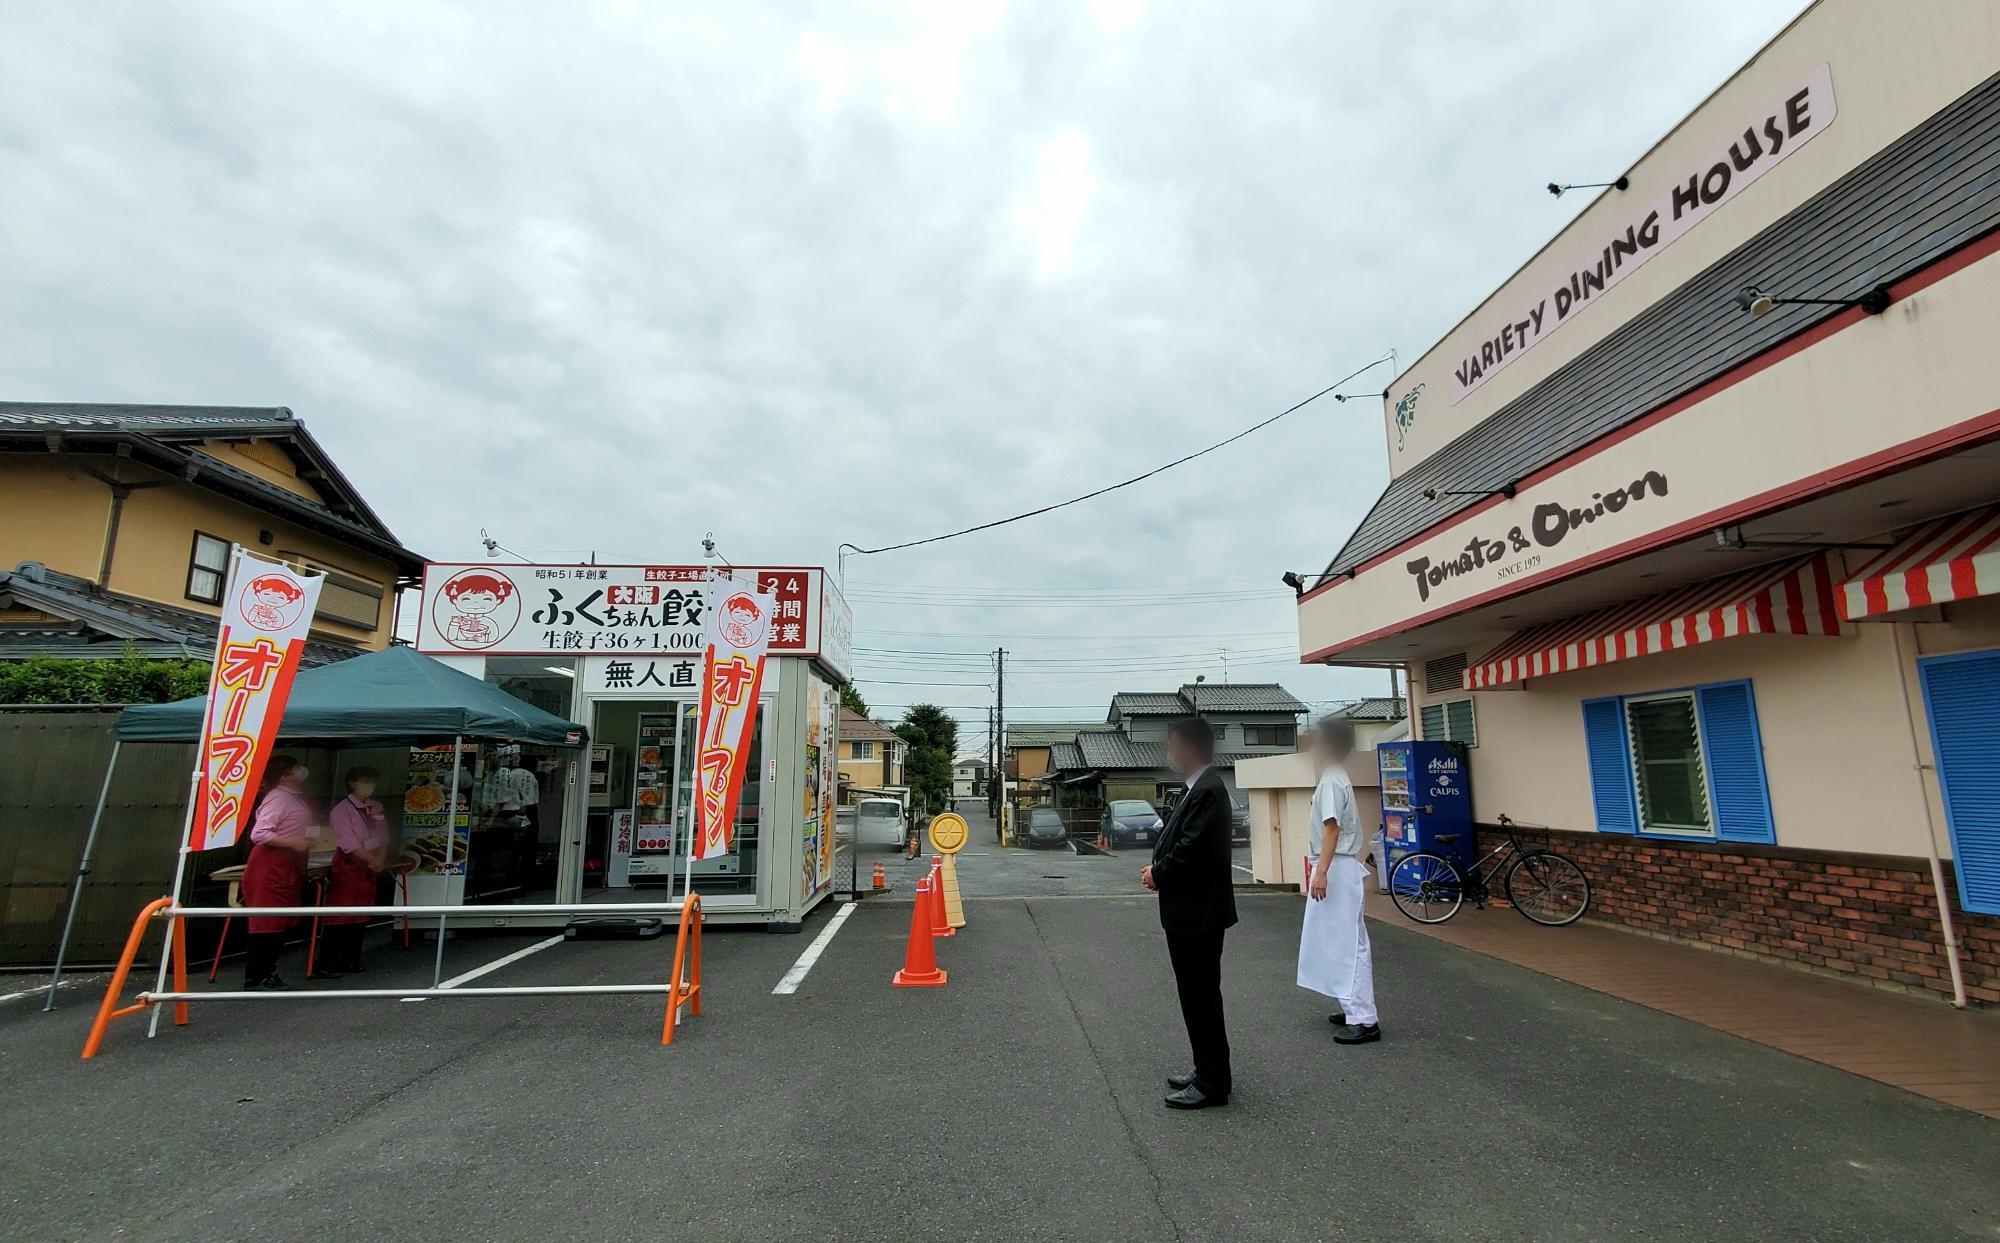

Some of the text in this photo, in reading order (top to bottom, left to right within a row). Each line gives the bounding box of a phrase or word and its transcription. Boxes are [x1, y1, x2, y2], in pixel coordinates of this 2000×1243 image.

[1455, 87, 1811, 388] VARIETY DINING HOUSE
[1406, 470, 1669, 602] Tomato & Onion
[535, 569, 608, 581] 昭和51年創業
[646, 570, 731, 582] 生餃子工場直所
[1497, 554, 1541, 580] SINCE 1979
[532, 588, 712, 628] ふくちぁん餃
[614, 586, 653, 605] 大阪
[211, 640, 284, 838] オープン
[702, 656, 755, 846] オープン
[1428, 757, 1458, 770] Asahi
[1430, 787, 1460, 797] CALPIS
[617, 813, 632, 854] 保冷剤
